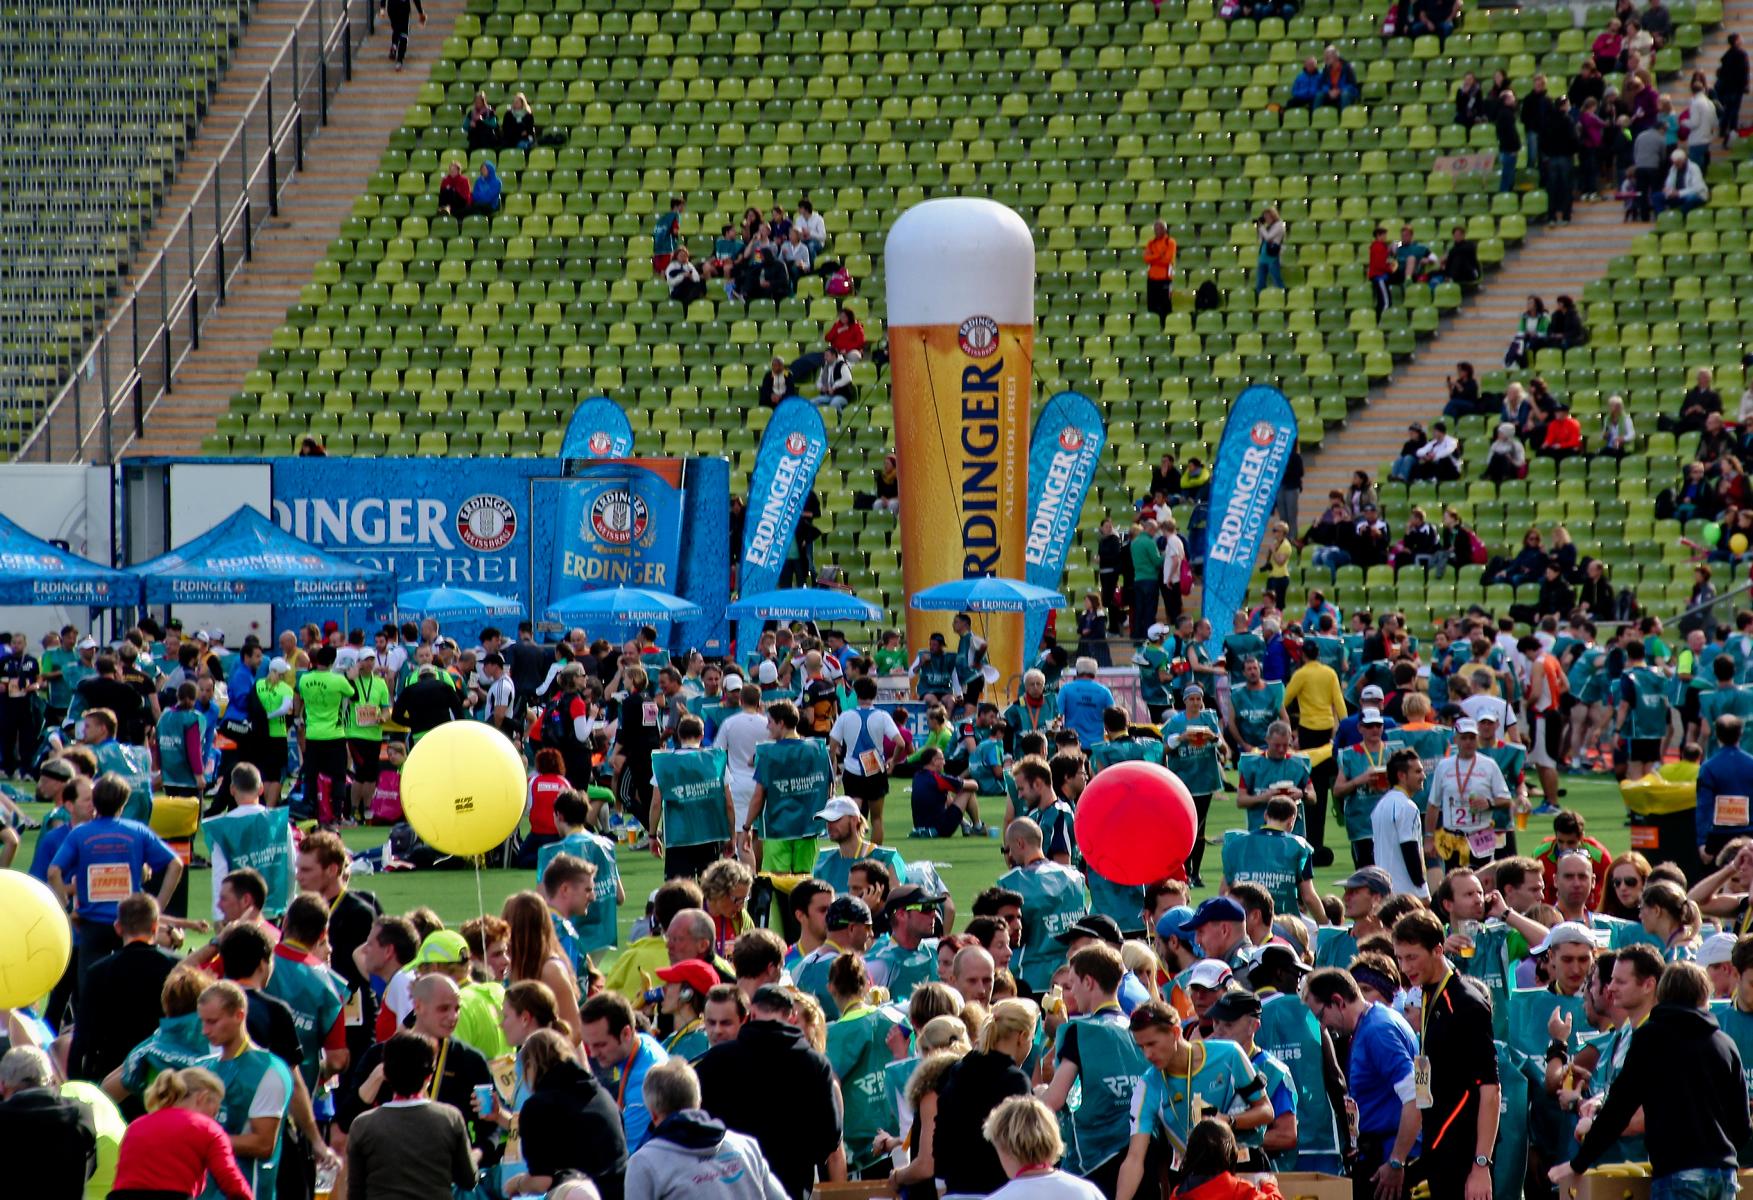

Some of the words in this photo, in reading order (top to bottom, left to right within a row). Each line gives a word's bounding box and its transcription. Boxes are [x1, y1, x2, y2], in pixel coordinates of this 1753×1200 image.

[1005, 376, 1016, 521] ALKOHOLFREI
[961, 356, 1004, 580] RDINGER
[461, 497, 512, 520] ERDINGER
[1025, 451, 1079, 566] ERDINGER
[1046, 432, 1099, 570] ALKOHOLFREI
[1210, 446, 1270, 564] ERDINGER
[1235, 426, 1291, 568] ALKOHOLFREI
[746, 455, 802, 567] ERDINGER
[33, 581, 94, 593] ERDINGER
[172, 579, 232, 592] ERDINGER
[294, 578, 353, 593] ERDINGER
[628, 610, 669, 621] ERDINGER
[769, 607, 809, 617] ERDINGER
[982, 600, 1023, 610] ERDINGER
[1252, 872, 1296, 884] RUNNERS
